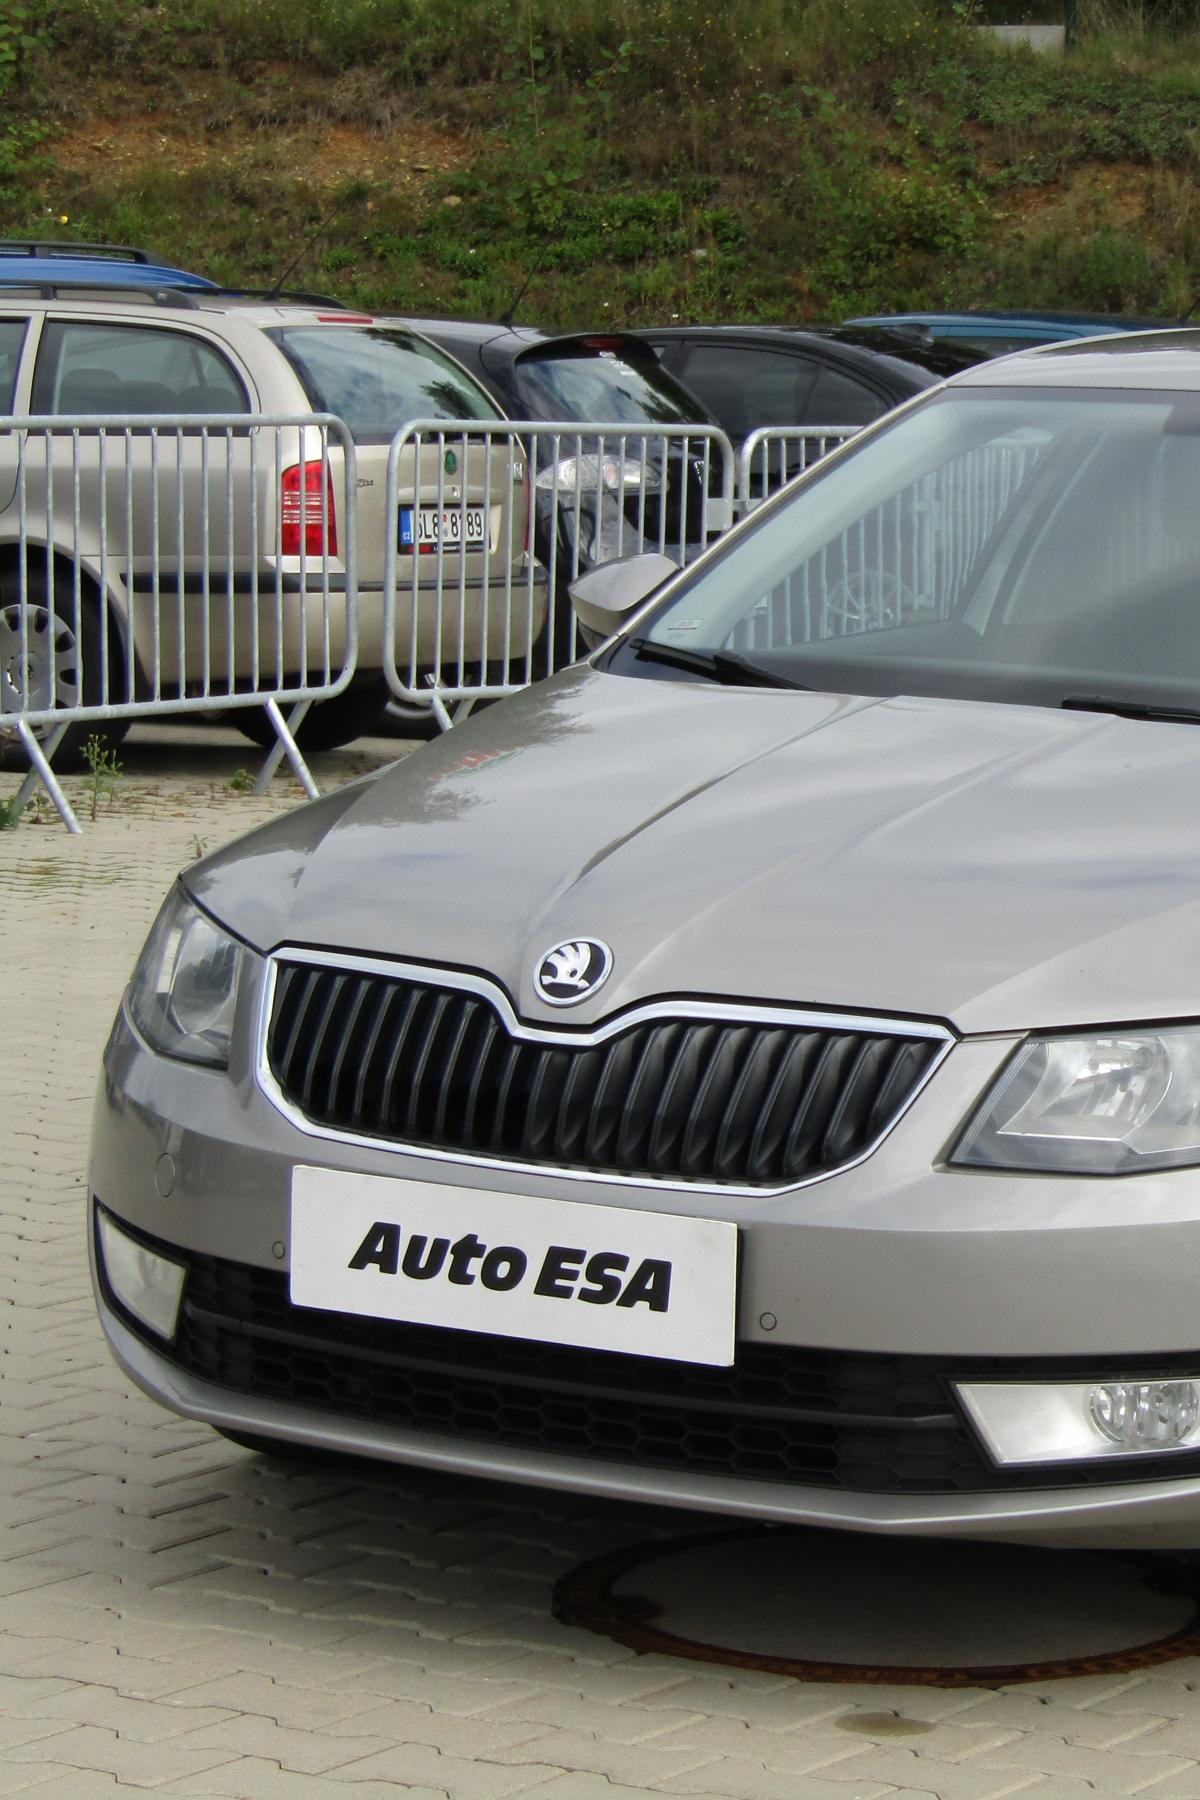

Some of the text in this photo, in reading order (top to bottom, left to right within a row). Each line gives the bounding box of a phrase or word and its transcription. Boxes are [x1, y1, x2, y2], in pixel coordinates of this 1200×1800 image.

[450, 511, 483, 538] 889
[347, 1221, 672, 1313] Auto ESA
